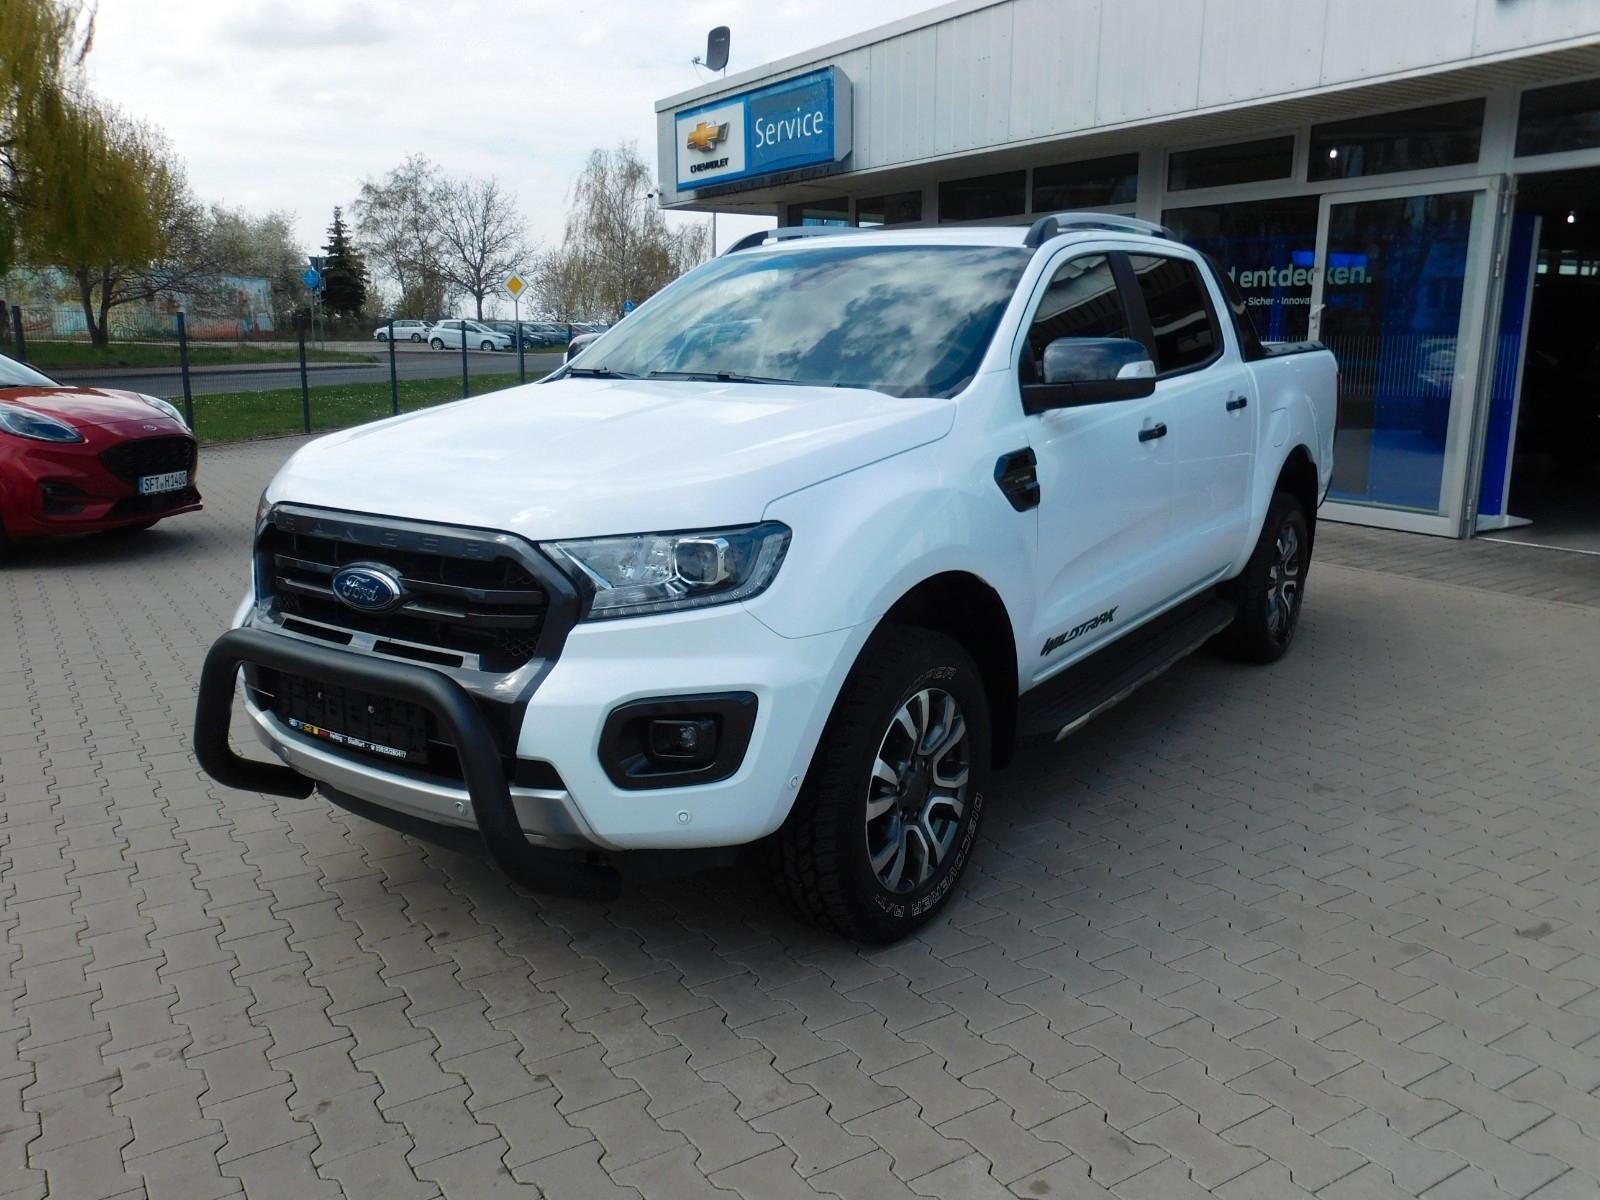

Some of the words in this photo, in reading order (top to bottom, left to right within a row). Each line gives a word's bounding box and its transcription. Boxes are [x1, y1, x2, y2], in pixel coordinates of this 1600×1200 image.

[755, 106, 824, 148] Service
[690, 157, 729, 174] CHEVROLET
[1248, 297, 1274, 306] Sicher
[145, 476, 160, 491] SFT
[341, 574, 379, 602] Ford
[1040, 605, 1119, 656] WILDTRAK
[911, 791, 984, 917] DISCOVERER
